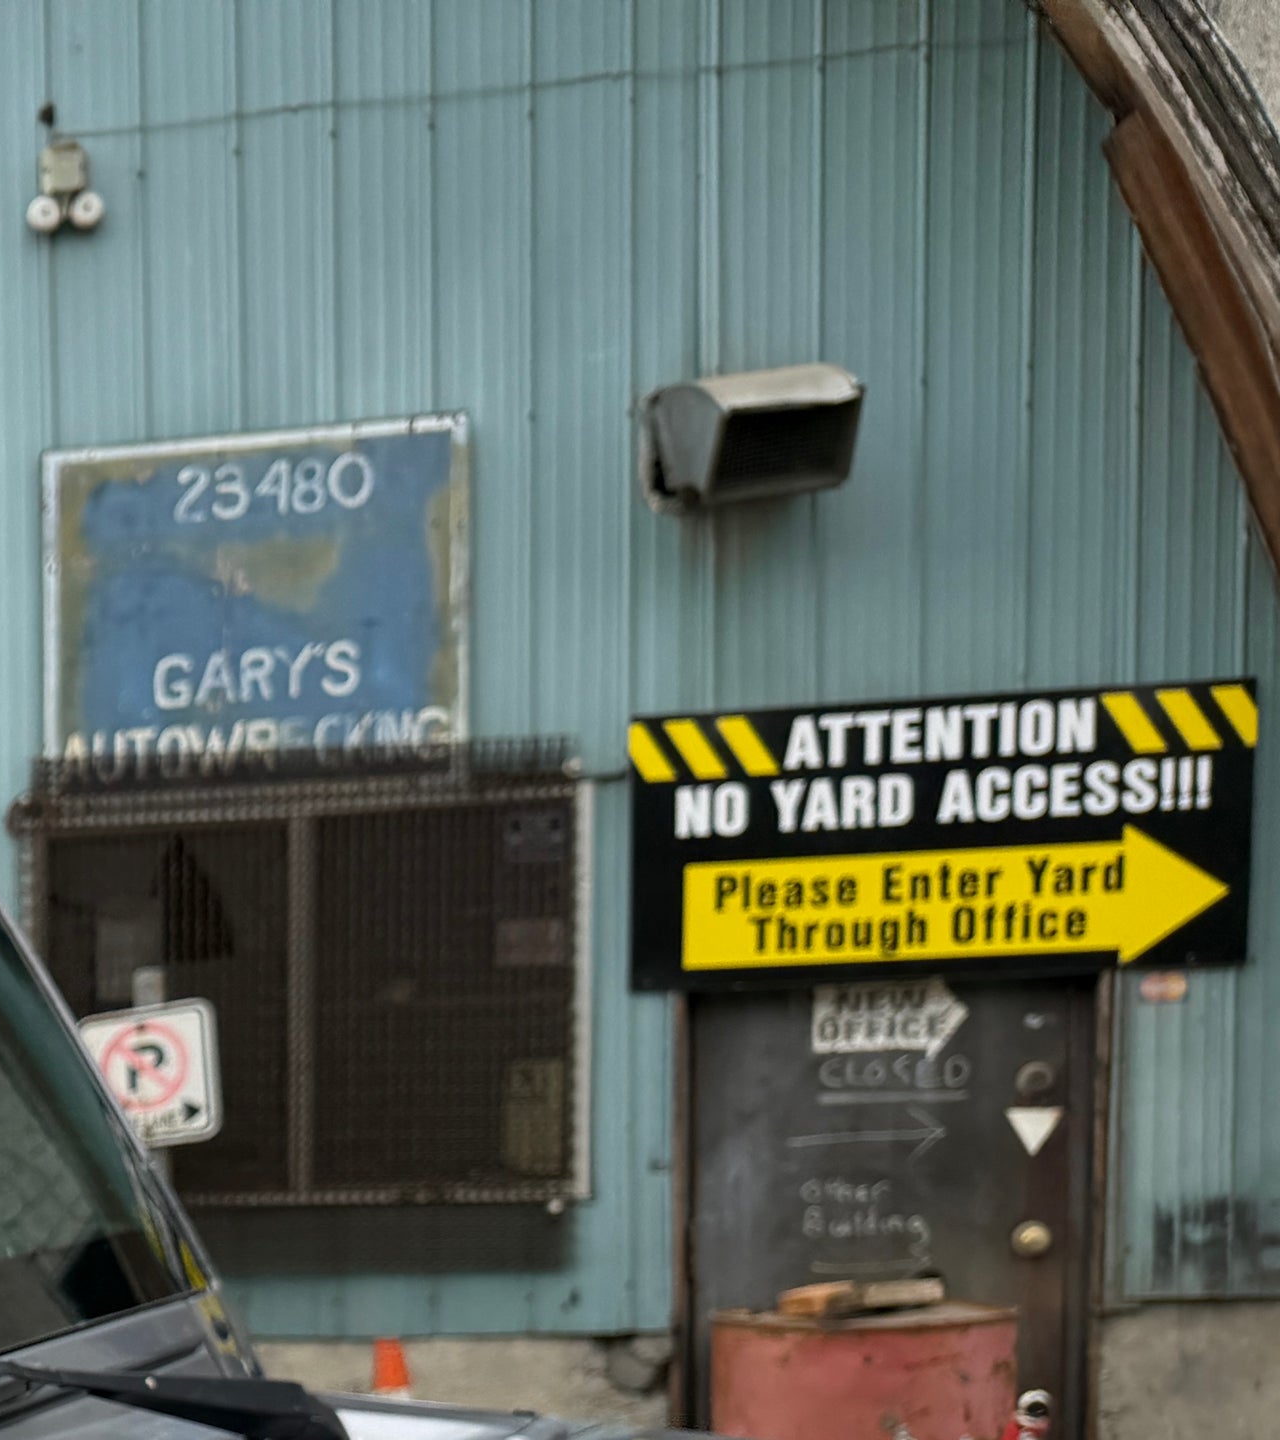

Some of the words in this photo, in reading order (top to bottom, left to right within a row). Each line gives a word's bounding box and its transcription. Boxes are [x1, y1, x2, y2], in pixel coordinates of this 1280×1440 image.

[174, 451, 375, 523] 23480
[153, 638, 362, 710] GARY'S
[782, 695, 1099, 771] ATTENTION
[674, 781, 749, 840] NO
[770, 771, 915, 834] YARD
[936, 754, 1214, 825] ACCESS!!!
[712, 872, 858, 913] Please
[880, 864, 1004, 904] Enter
[1026, 853, 1127, 896] Yard
[749, 910, 928, 955] Through
[950, 904, 1089, 945] Office
